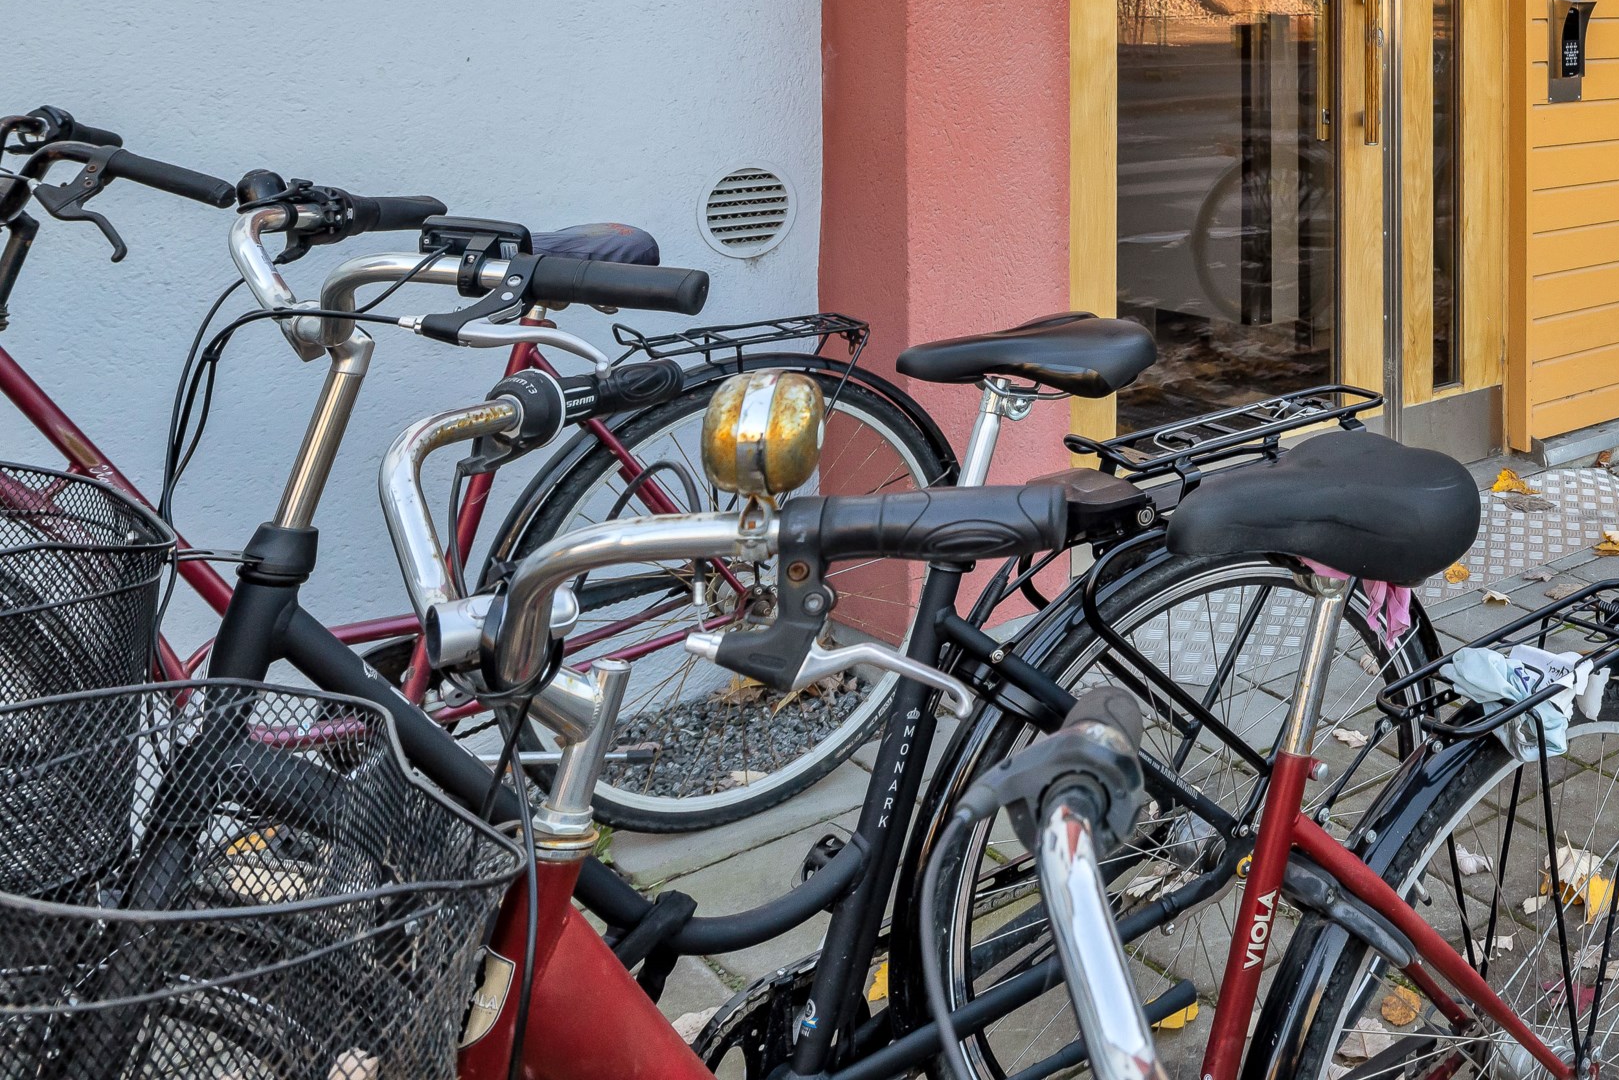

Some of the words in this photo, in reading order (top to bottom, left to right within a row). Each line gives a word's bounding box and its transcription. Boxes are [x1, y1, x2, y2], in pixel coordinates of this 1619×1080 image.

[566, 395, 595, 408] SRAM
[878, 725, 915, 828] MONARK
[1243, 889, 1277, 970] VIOLA
